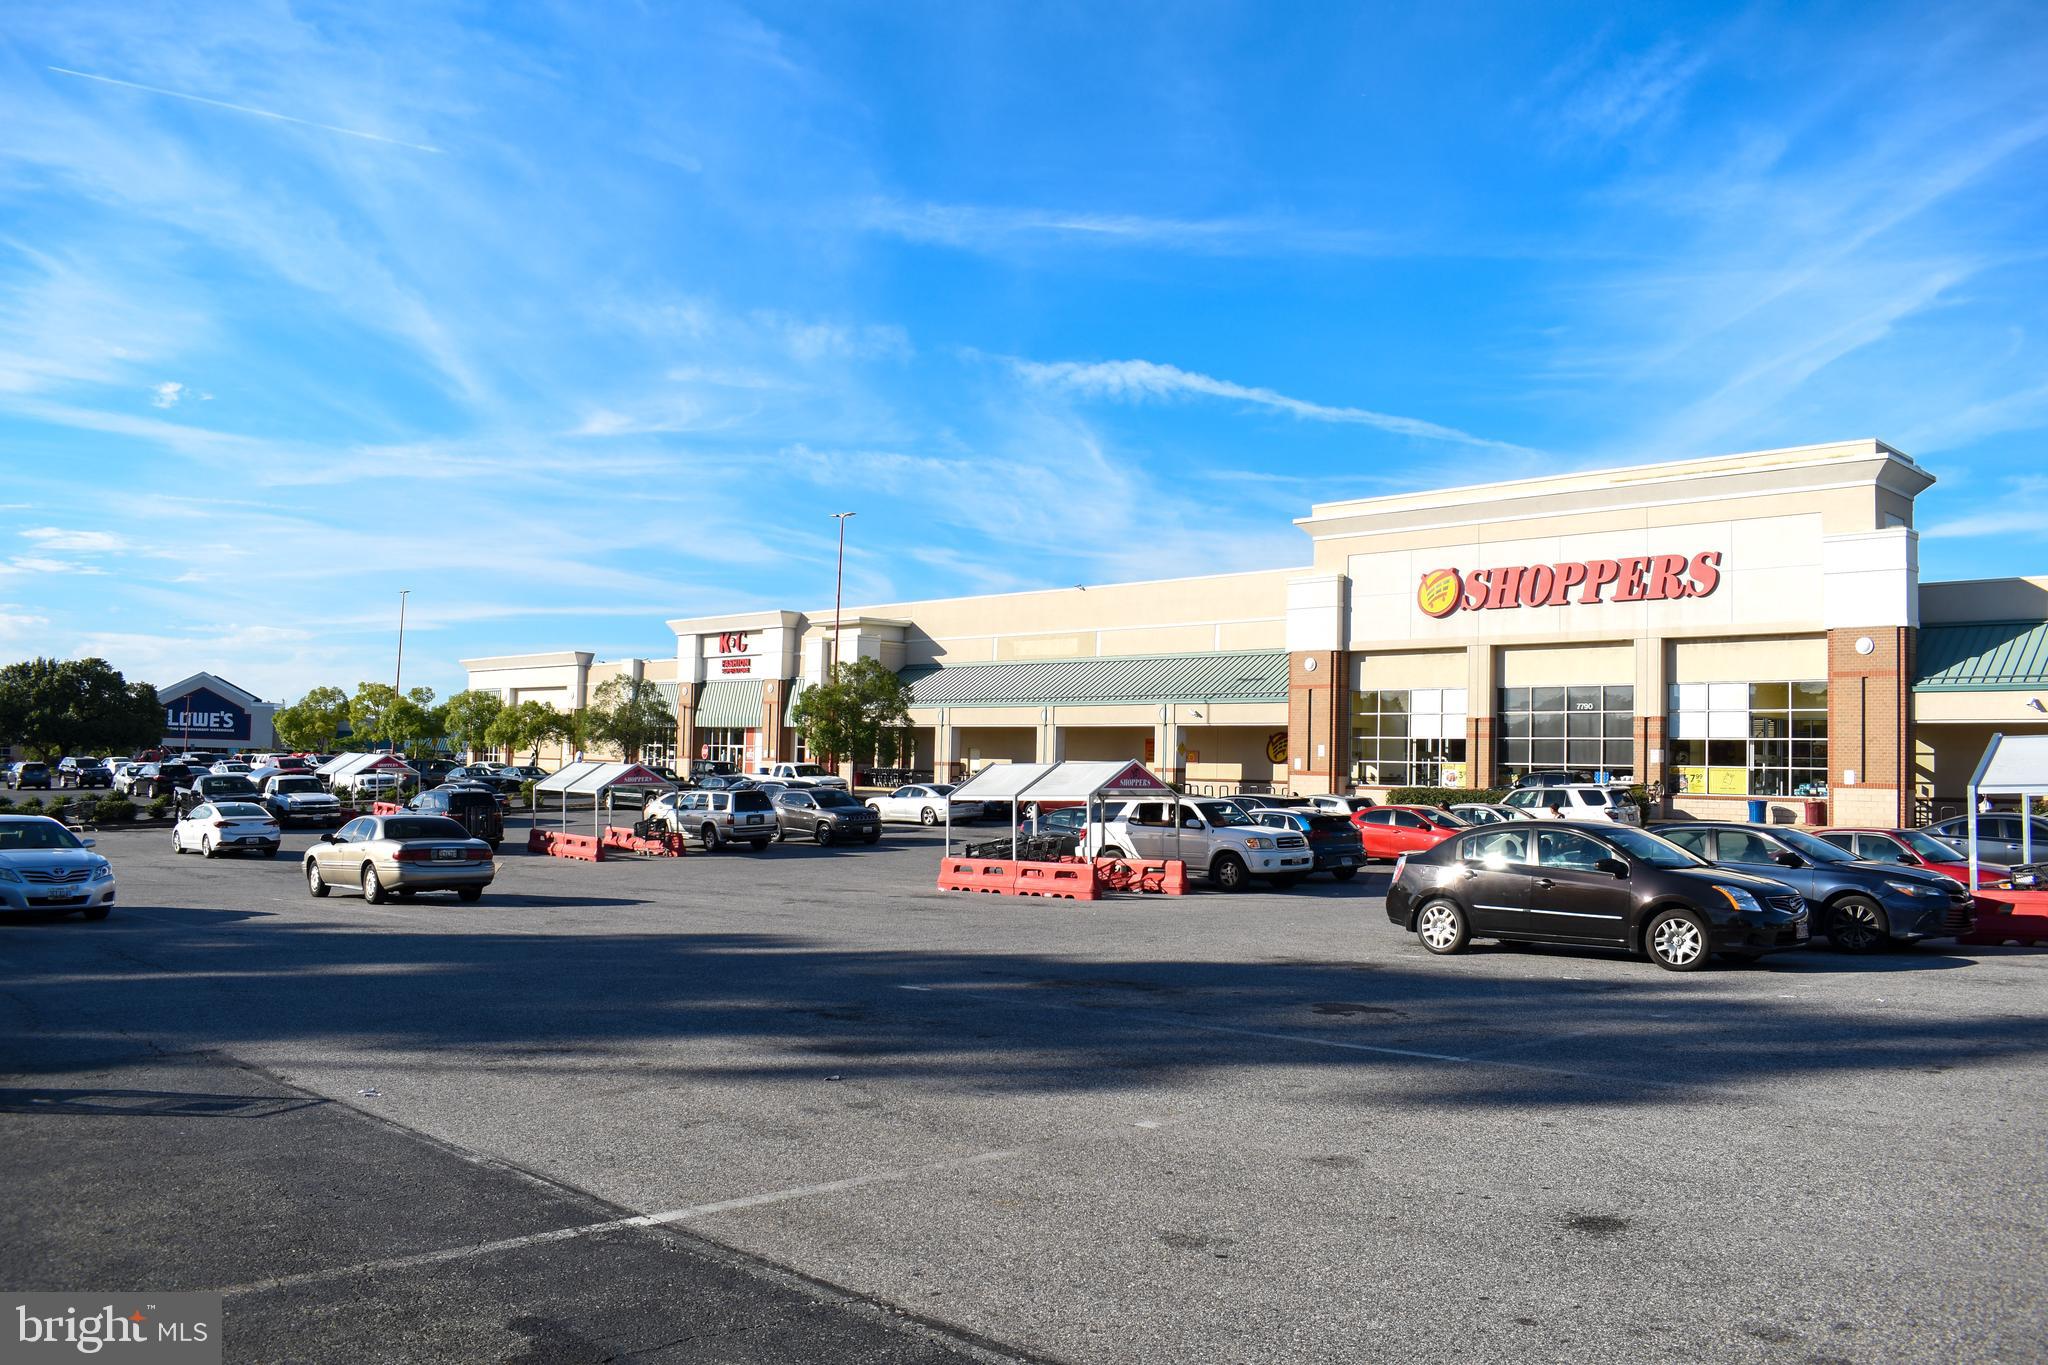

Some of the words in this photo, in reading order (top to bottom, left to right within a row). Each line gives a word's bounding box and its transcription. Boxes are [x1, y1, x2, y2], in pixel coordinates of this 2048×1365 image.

[1461, 550, 1723, 611] SHOPPERS
[722, 658, 751, 667] FASHION
[168, 709, 234, 728] LOWE'S
[1120, 778, 1151, 786] SHOPPERS
